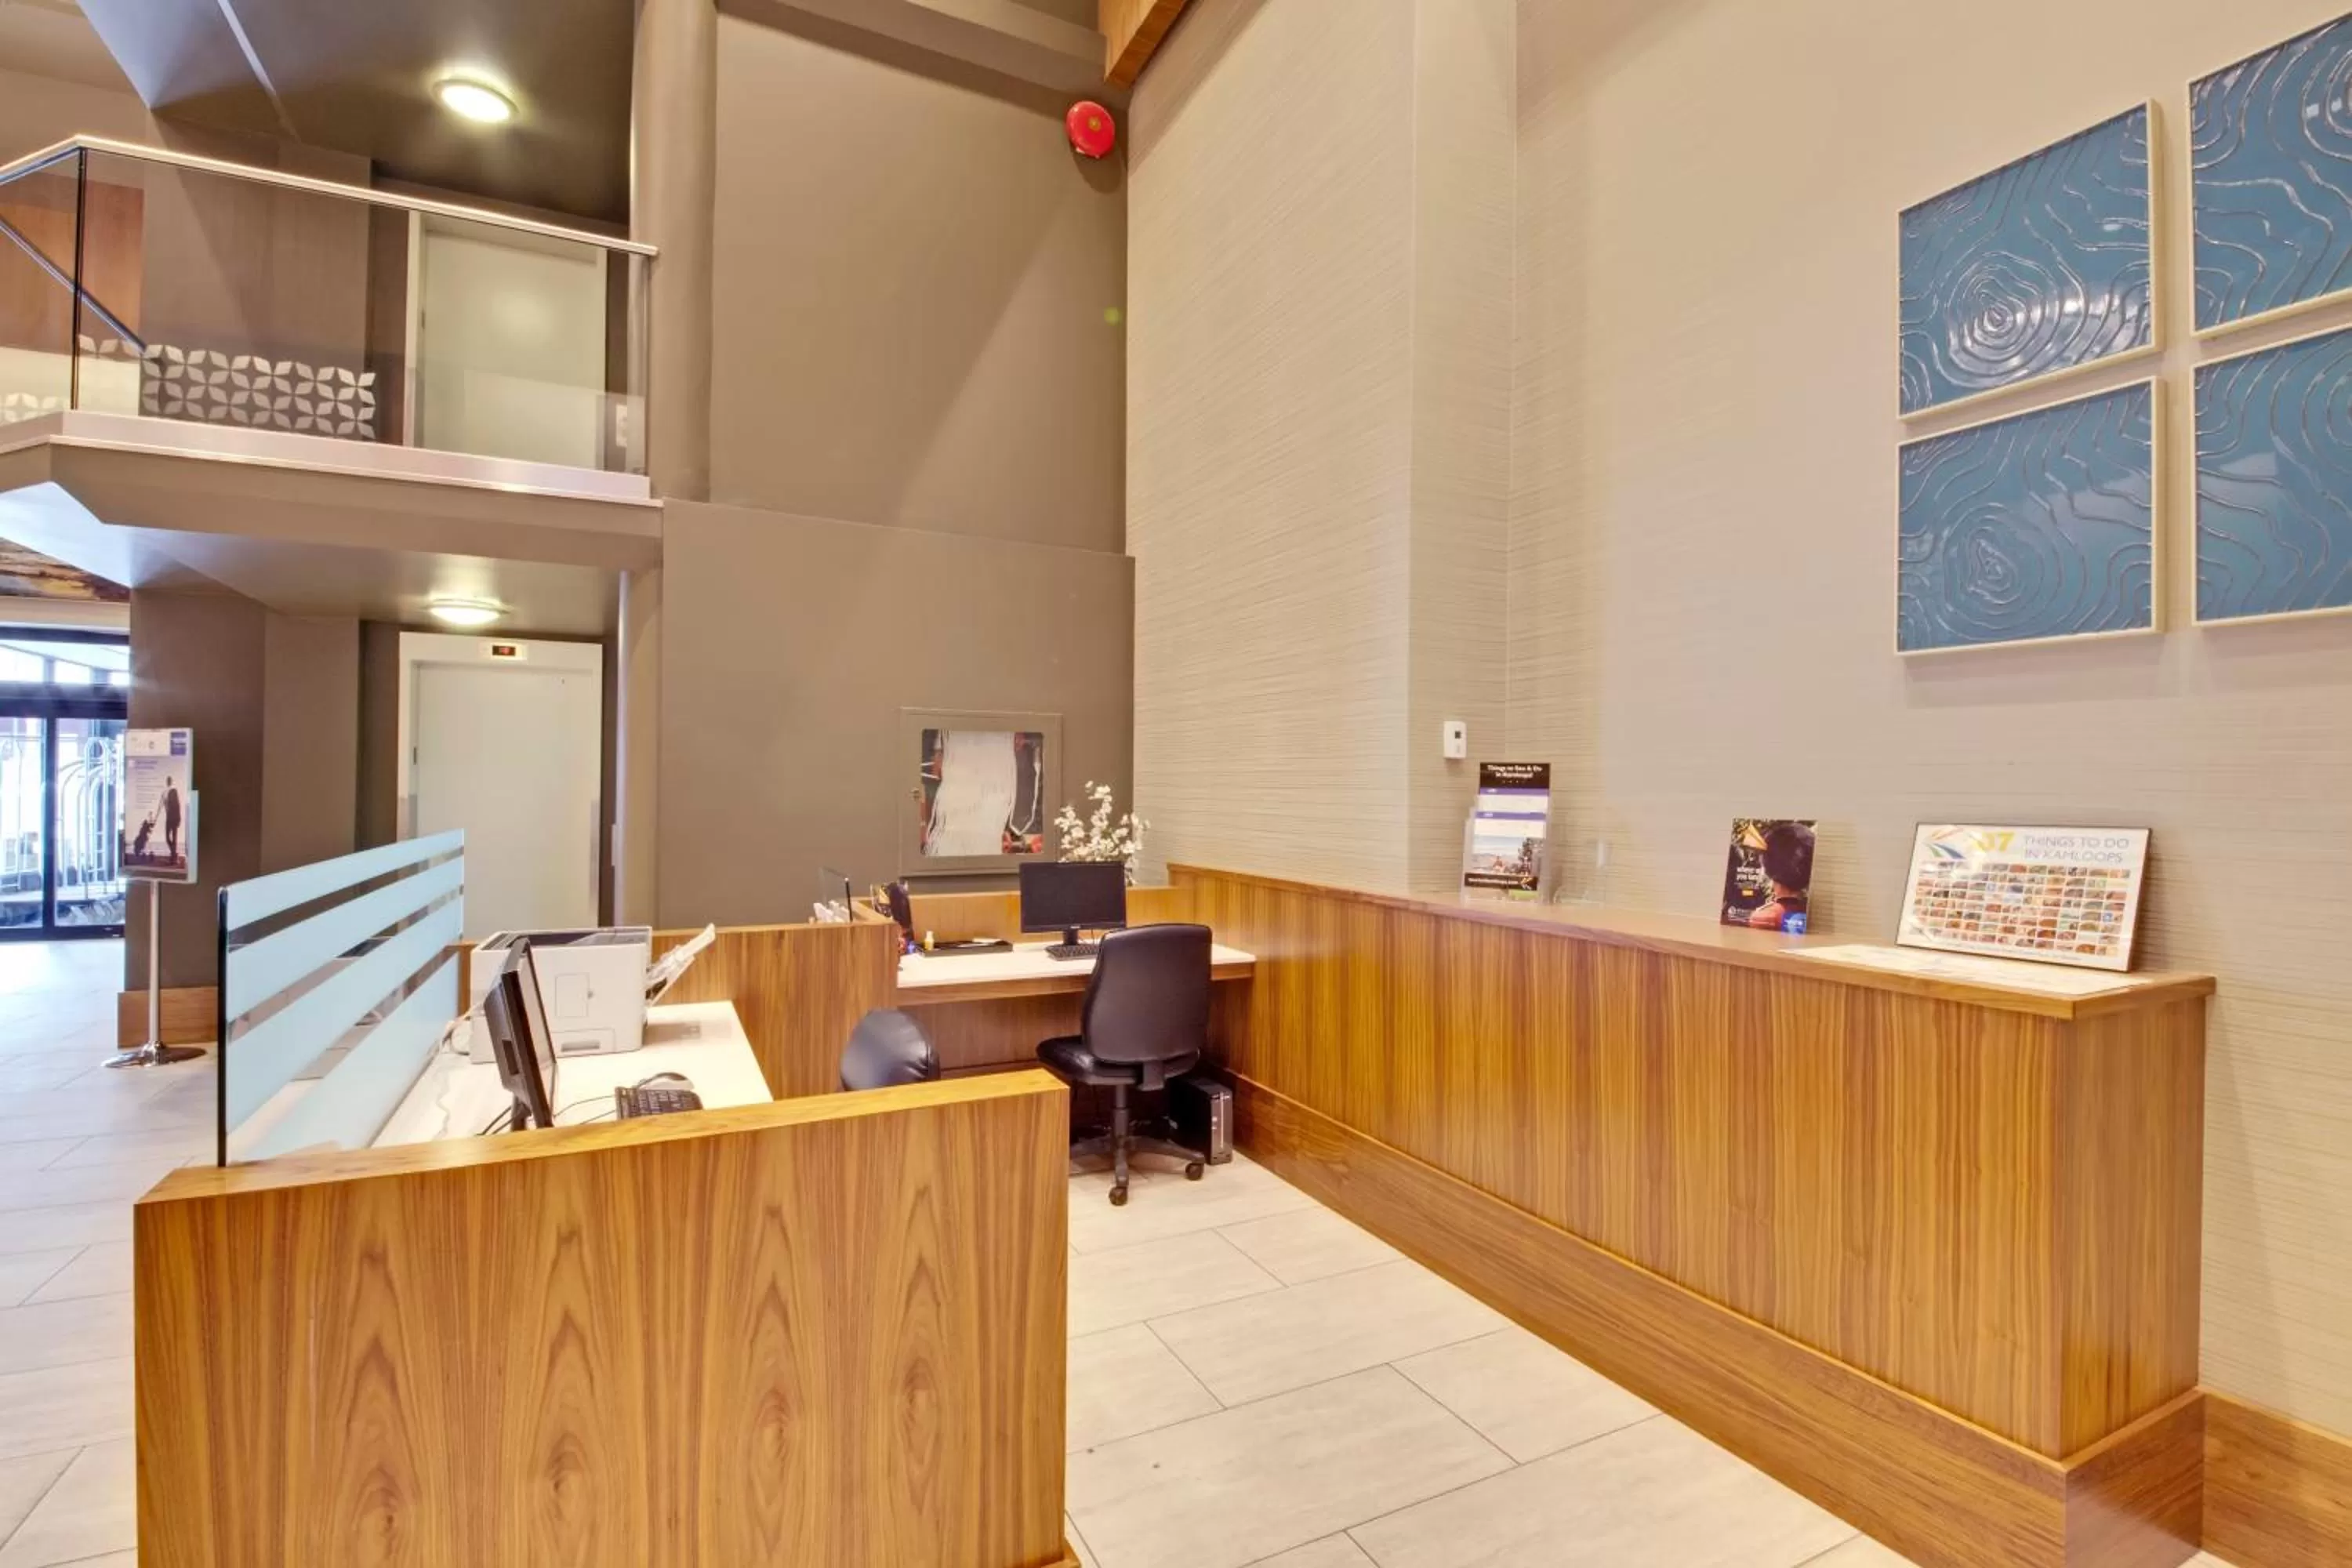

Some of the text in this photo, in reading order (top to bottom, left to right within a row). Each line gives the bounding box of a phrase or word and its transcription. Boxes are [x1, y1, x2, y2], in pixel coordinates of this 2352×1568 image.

[2024, 836, 2129, 849] THINGS TO DO
[2024, 849, 2124, 863] IN KAMLOOPS
